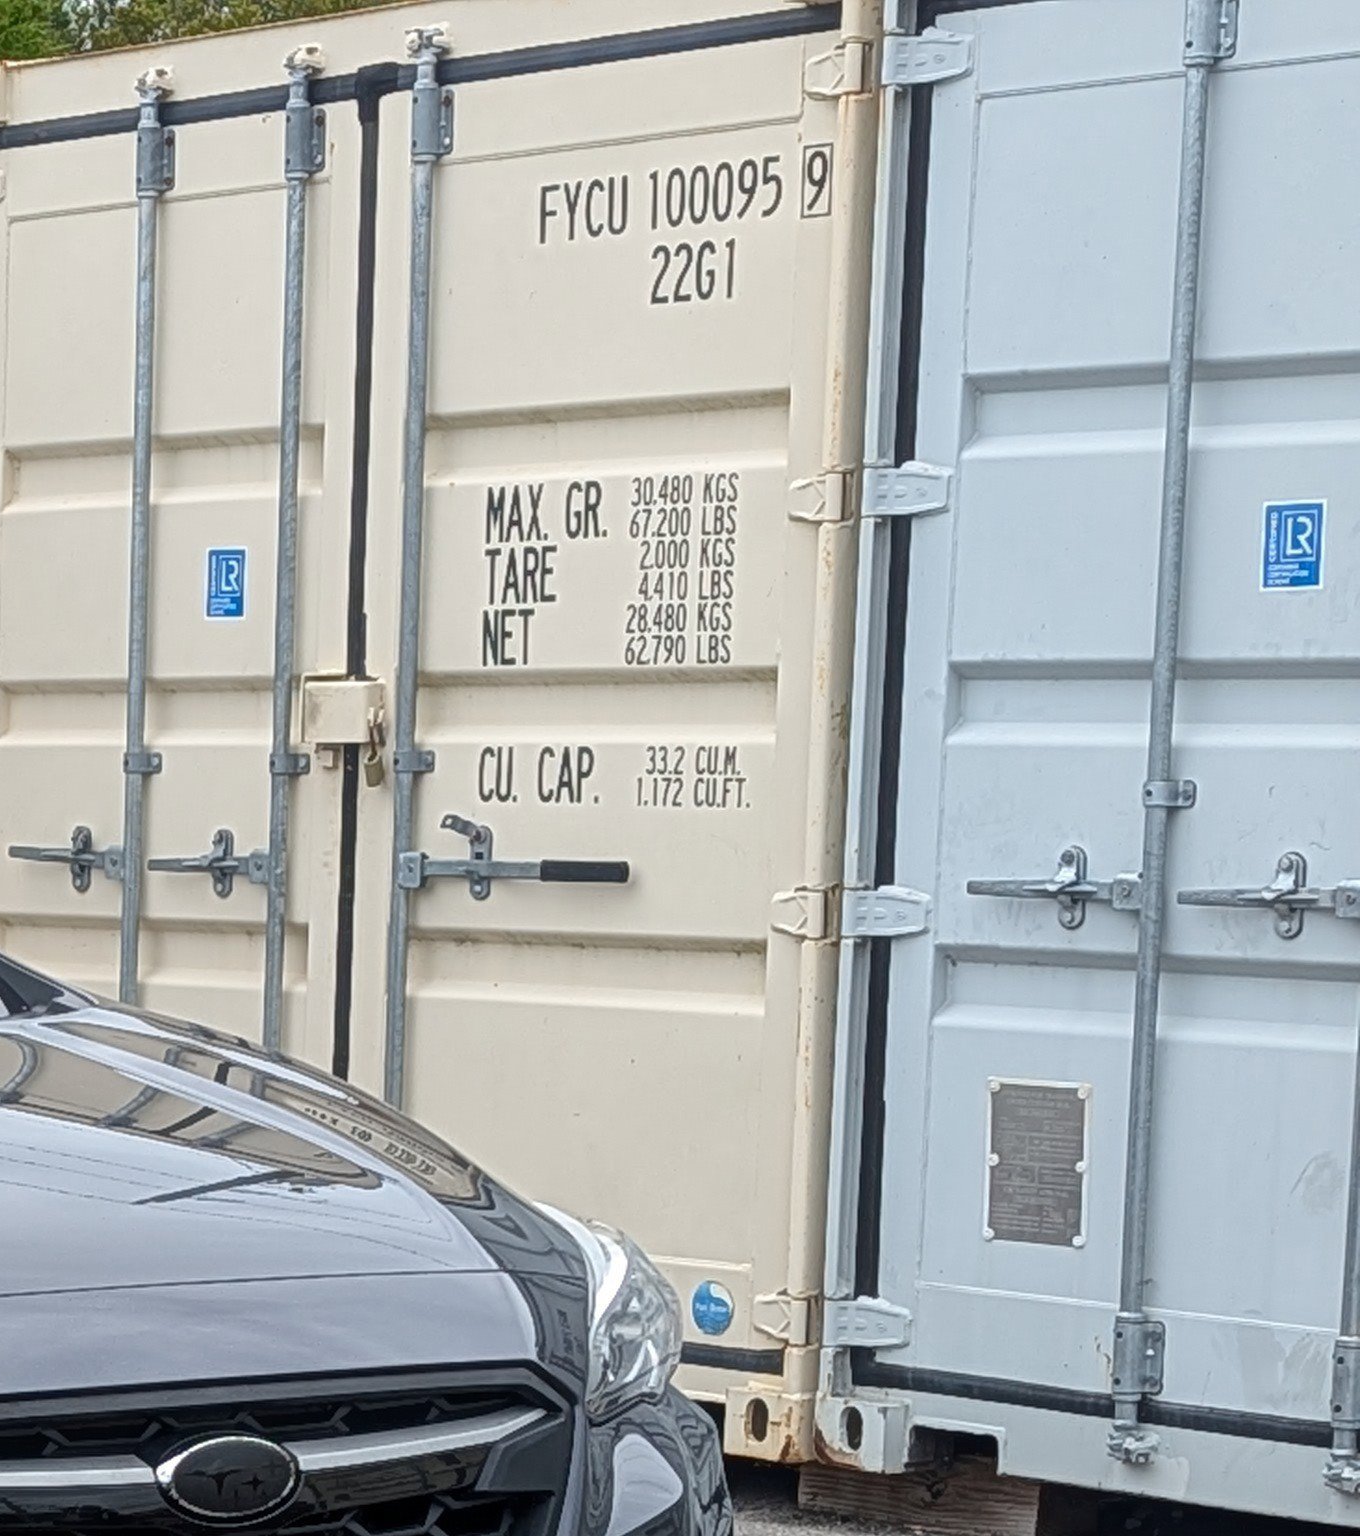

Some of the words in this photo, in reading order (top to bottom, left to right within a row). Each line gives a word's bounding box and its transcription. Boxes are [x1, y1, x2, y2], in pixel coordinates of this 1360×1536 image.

[539, 174, 628, 245] FYCU
[649, 155, 782, 230] 100095
[806, 150, 829, 212] 9
[650, 237, 736, 305] 22G1
[485, 483, 549, 545] MAX.
[565, 480, 608, 540] GR.
[702, 472, 739, 504] KGS
[701, 504, 738, 536] LBS
[484, 545, 558, 606] TARE
[699, 536, 736, 569] KGS
[698, 569, 734, 601] LBS
[482, 608, 535, 667] NET
[697, 601, 733, 633] KGS
[696, 633, 732, 665] LBS
[478, 746, 518, 804] CU.
[537, 746, 599, 805] CAP.
[645, 745, 686, 776] 33.2
[695, 745, 741, 776] CU.M.
[637, 777, 684, 808] 1.172
[693, 777, 751, 810] CU.FT.
